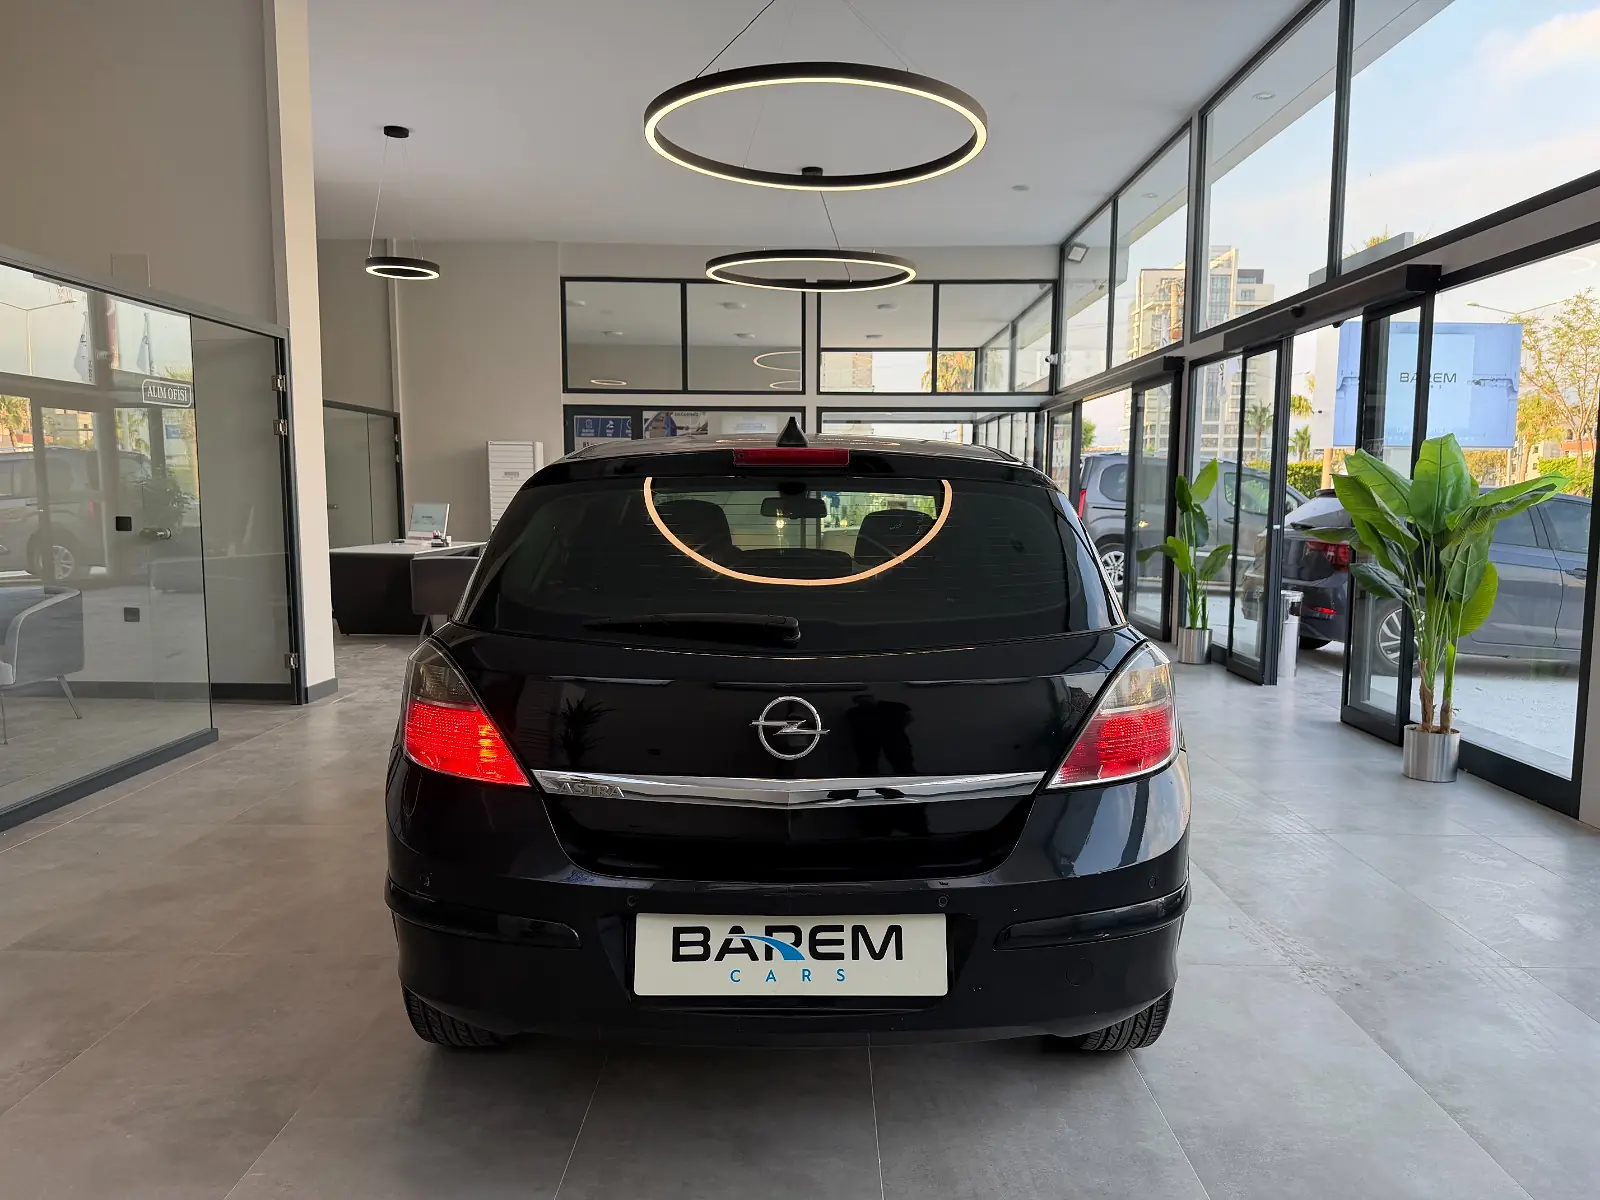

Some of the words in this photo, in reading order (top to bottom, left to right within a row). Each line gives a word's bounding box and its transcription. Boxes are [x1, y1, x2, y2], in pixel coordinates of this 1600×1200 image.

[1400, 372, 1457, 383] BAEM
[147, 385, 167, 399] ALIM
[168, 386, 188, 402] OFİSİ
[560, 782, 625, 798] ASTRA
[671, 924, 903, 962] BAREM
[730, 968, 846, 983] CARS
